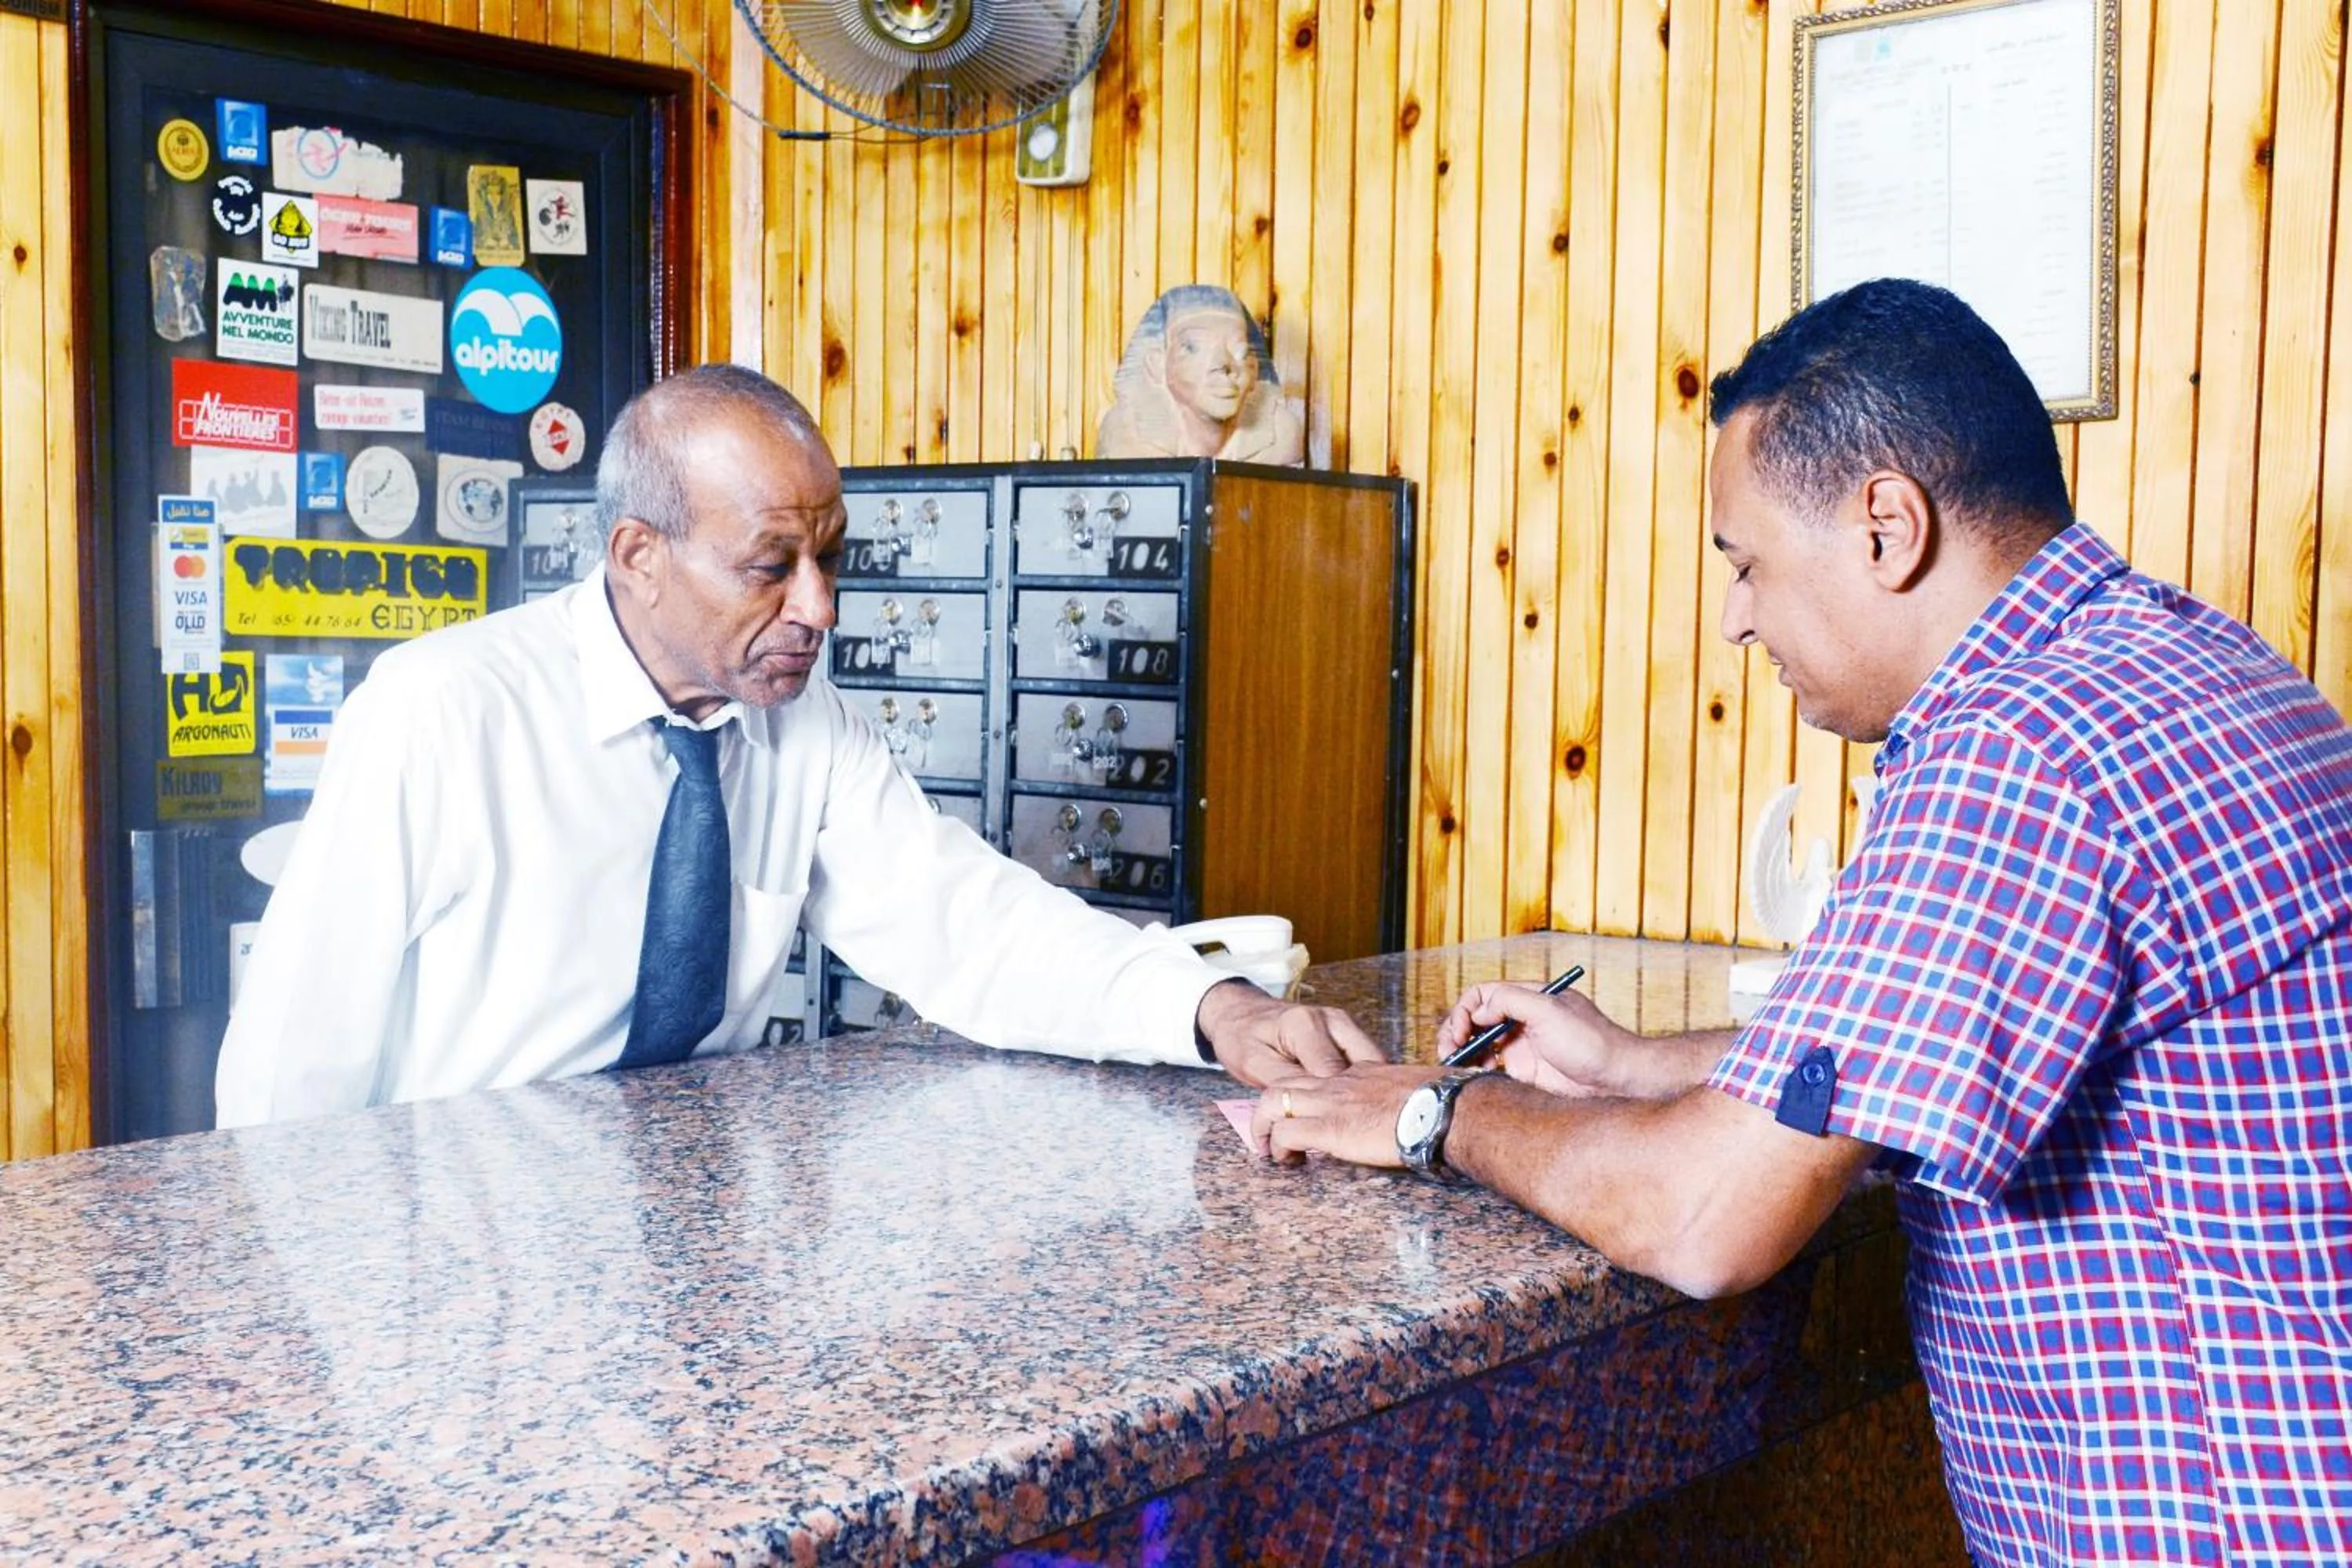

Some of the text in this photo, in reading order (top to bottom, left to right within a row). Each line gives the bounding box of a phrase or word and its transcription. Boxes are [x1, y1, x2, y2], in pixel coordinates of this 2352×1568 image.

[222, 310, 292, 330] AVVENTURE
[350, 300, 392, 349] TRAVEL
[222, 325, 294, 345] NEL MONDO
[455, 336, 559, 376] alpitour
[1118, 542, 1169, 572] 104
[175, 591, 208, 604] VISA
[371, 603, 477, 632] EGYPT
[844, 642, 889, 669] 10
[1118, 647, 1169, 676] 108
[172, 724, 252, 743] ARGONAUTI
[289, 726, 319, 739] VISA
[1108, 753, 1171, 785] 202
[768, 1022, 803, 1049] 02
